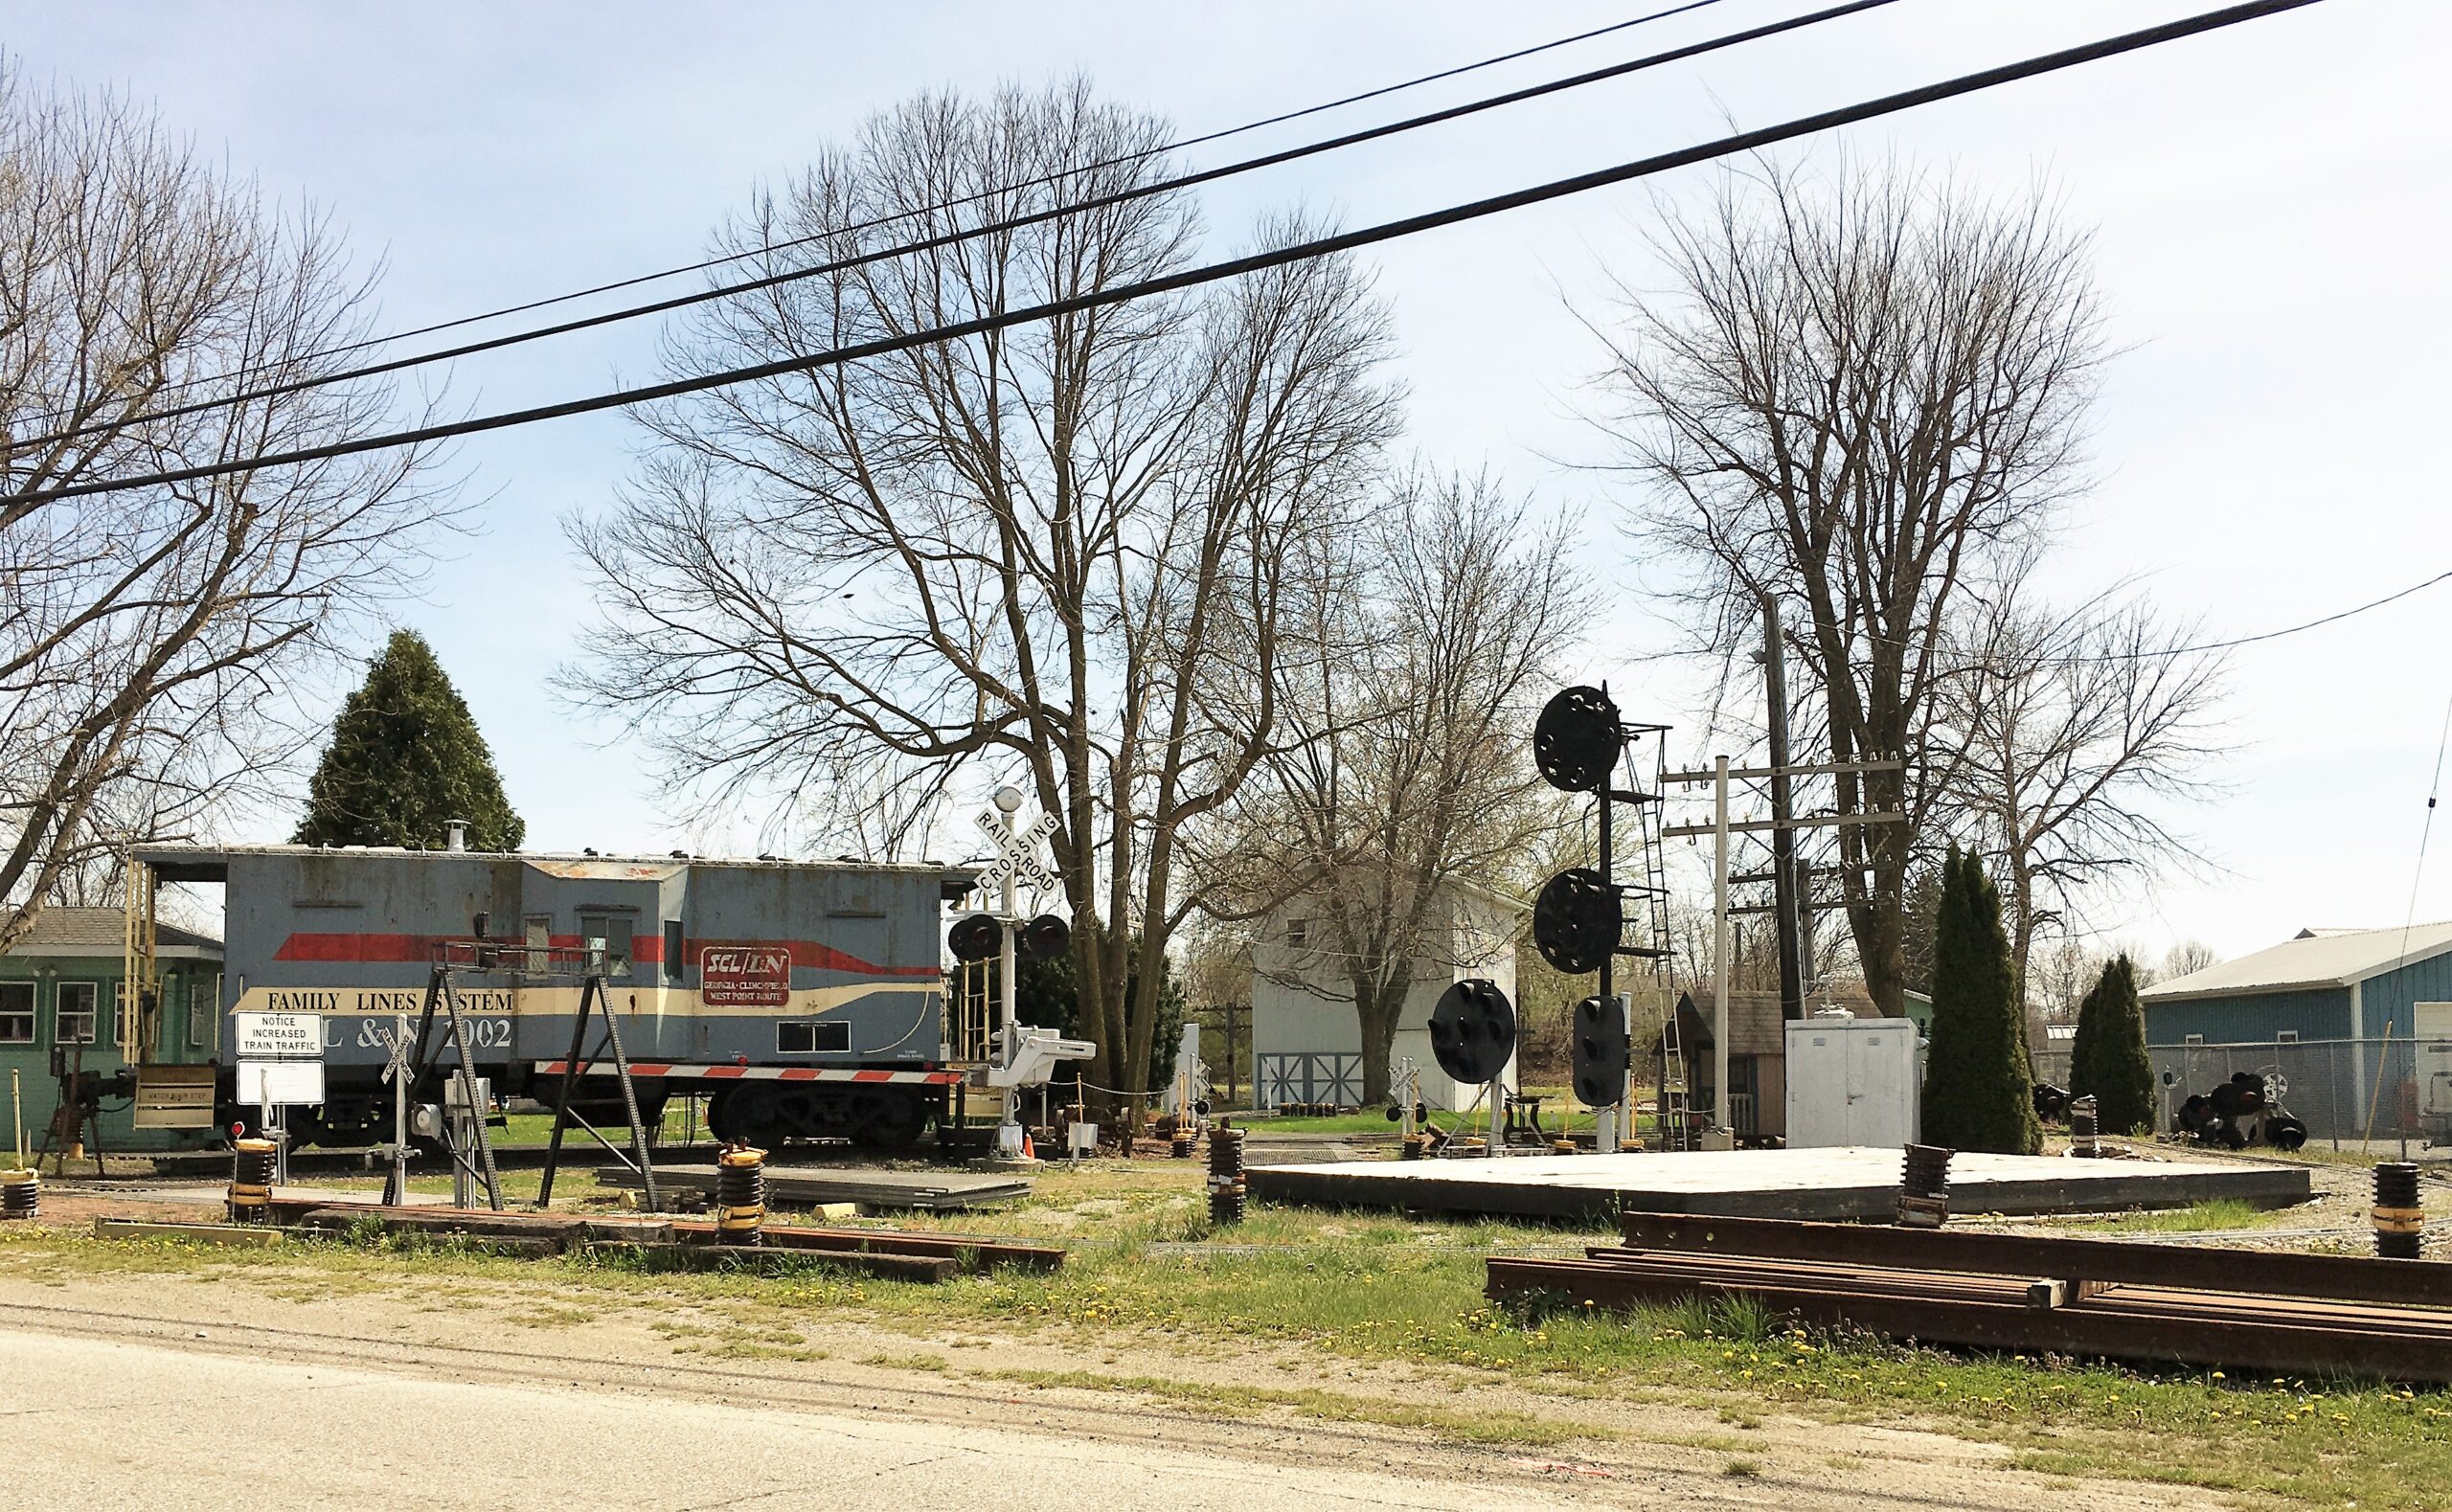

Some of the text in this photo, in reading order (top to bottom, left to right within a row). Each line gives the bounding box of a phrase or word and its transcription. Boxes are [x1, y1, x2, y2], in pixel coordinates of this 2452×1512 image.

[978, 811, 1055, 891] RAIL ROAD
[980, 816, 1056, 890] CROSSING
[704, 981, 788, 990] GEORGIA CLINCHFIELD
[268, 992, 340, 1010] FAMILY
[356, 992, 418, 1010] LINES
[710, 992, 783, 1001] WEST POINT ROUTE
[261, 1017, 296, 1027] NOTICE
[252, 1029, 306, 1038] INCREASED
[322, 1019, 344, 1048] L
[356, 1018, 385, 1048] &
[383, 1030, 395, 1052] RAIL
[244, 1042, 316, 1050] TRAIN TRAFFIC
[385, 1034, 410, 1075] CROSSING
